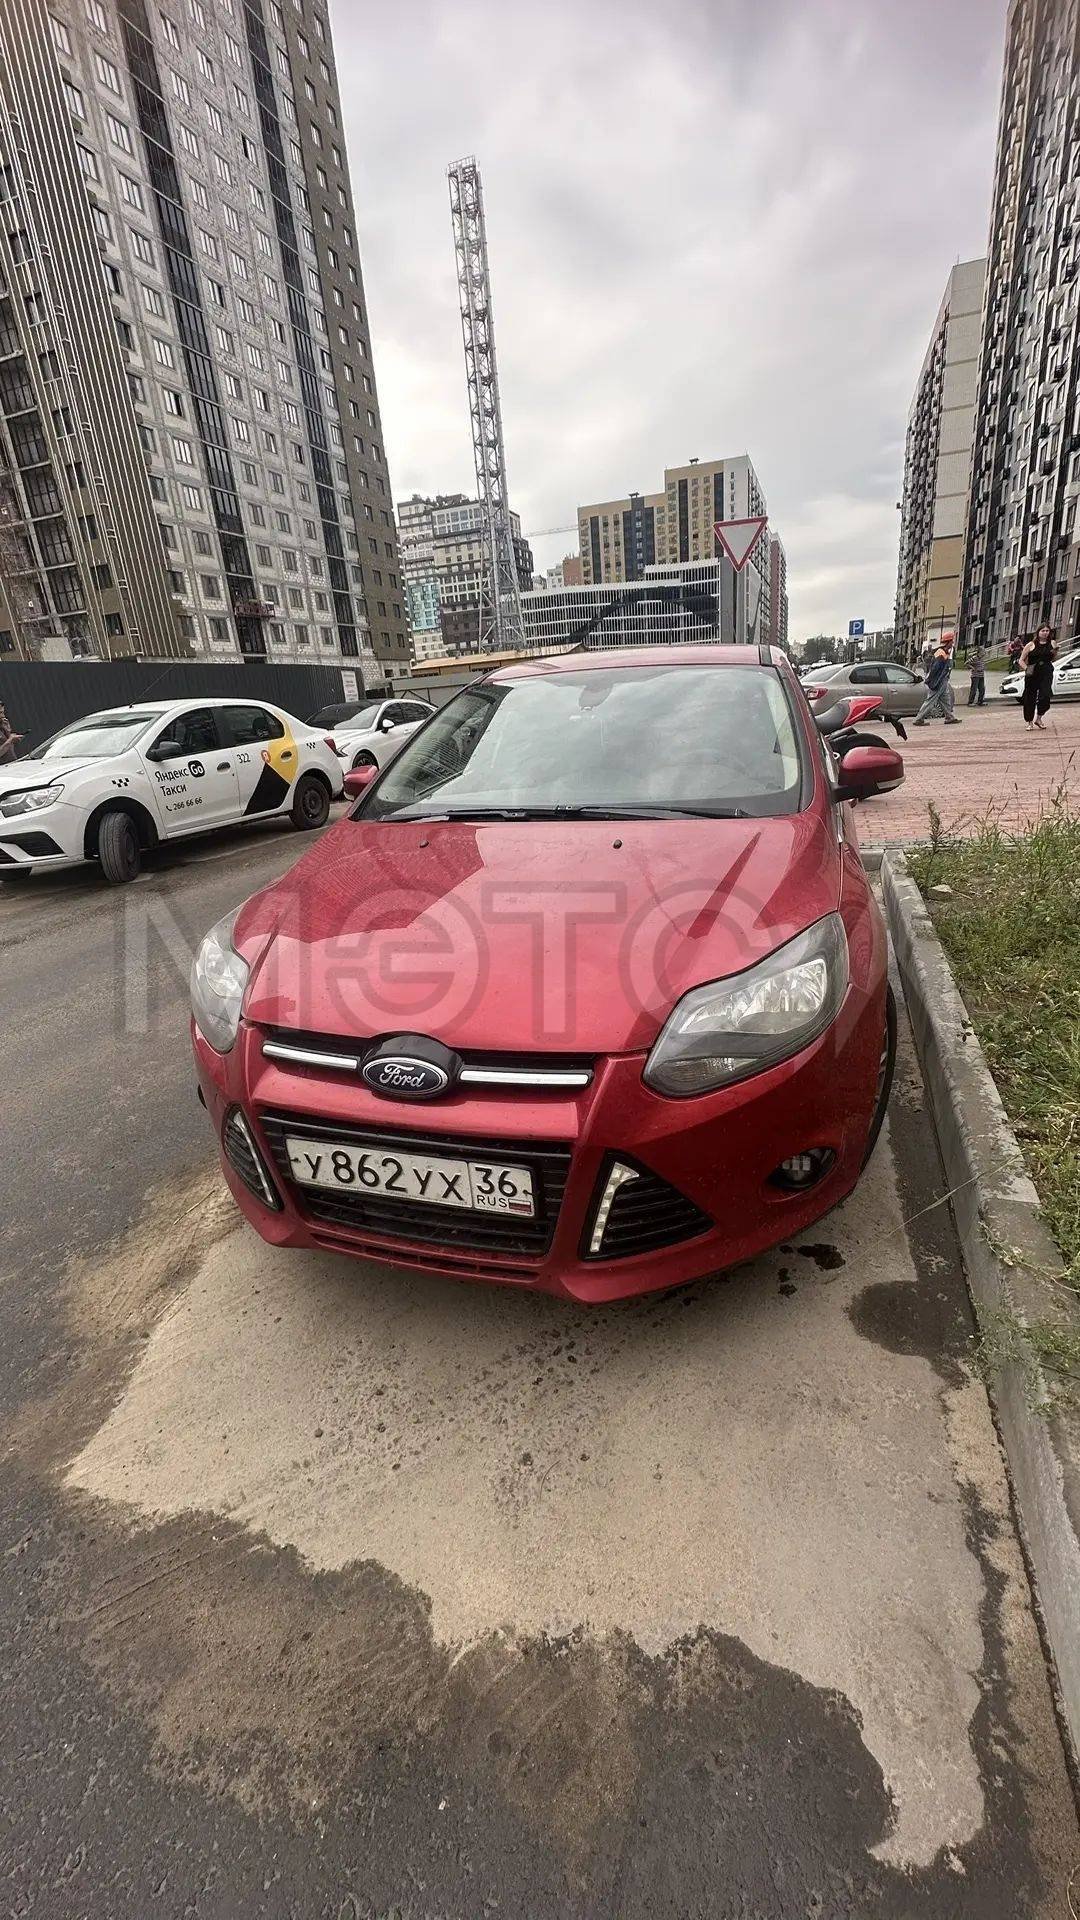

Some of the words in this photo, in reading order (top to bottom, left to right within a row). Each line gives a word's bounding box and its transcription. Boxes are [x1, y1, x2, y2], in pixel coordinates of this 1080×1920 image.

[236, 752, 251, 764] 322
[154, 768, 189, 782] Яндекс
[190, 763, 204, 775] Go
[160, 784, 187, 797] Такси
[173, 801, 185, 811] 266
[379, 1063, 426, 1088] Ford
[475, 1166, 518, 1198] 36
[476, 1195, 508, 1209] RUS
